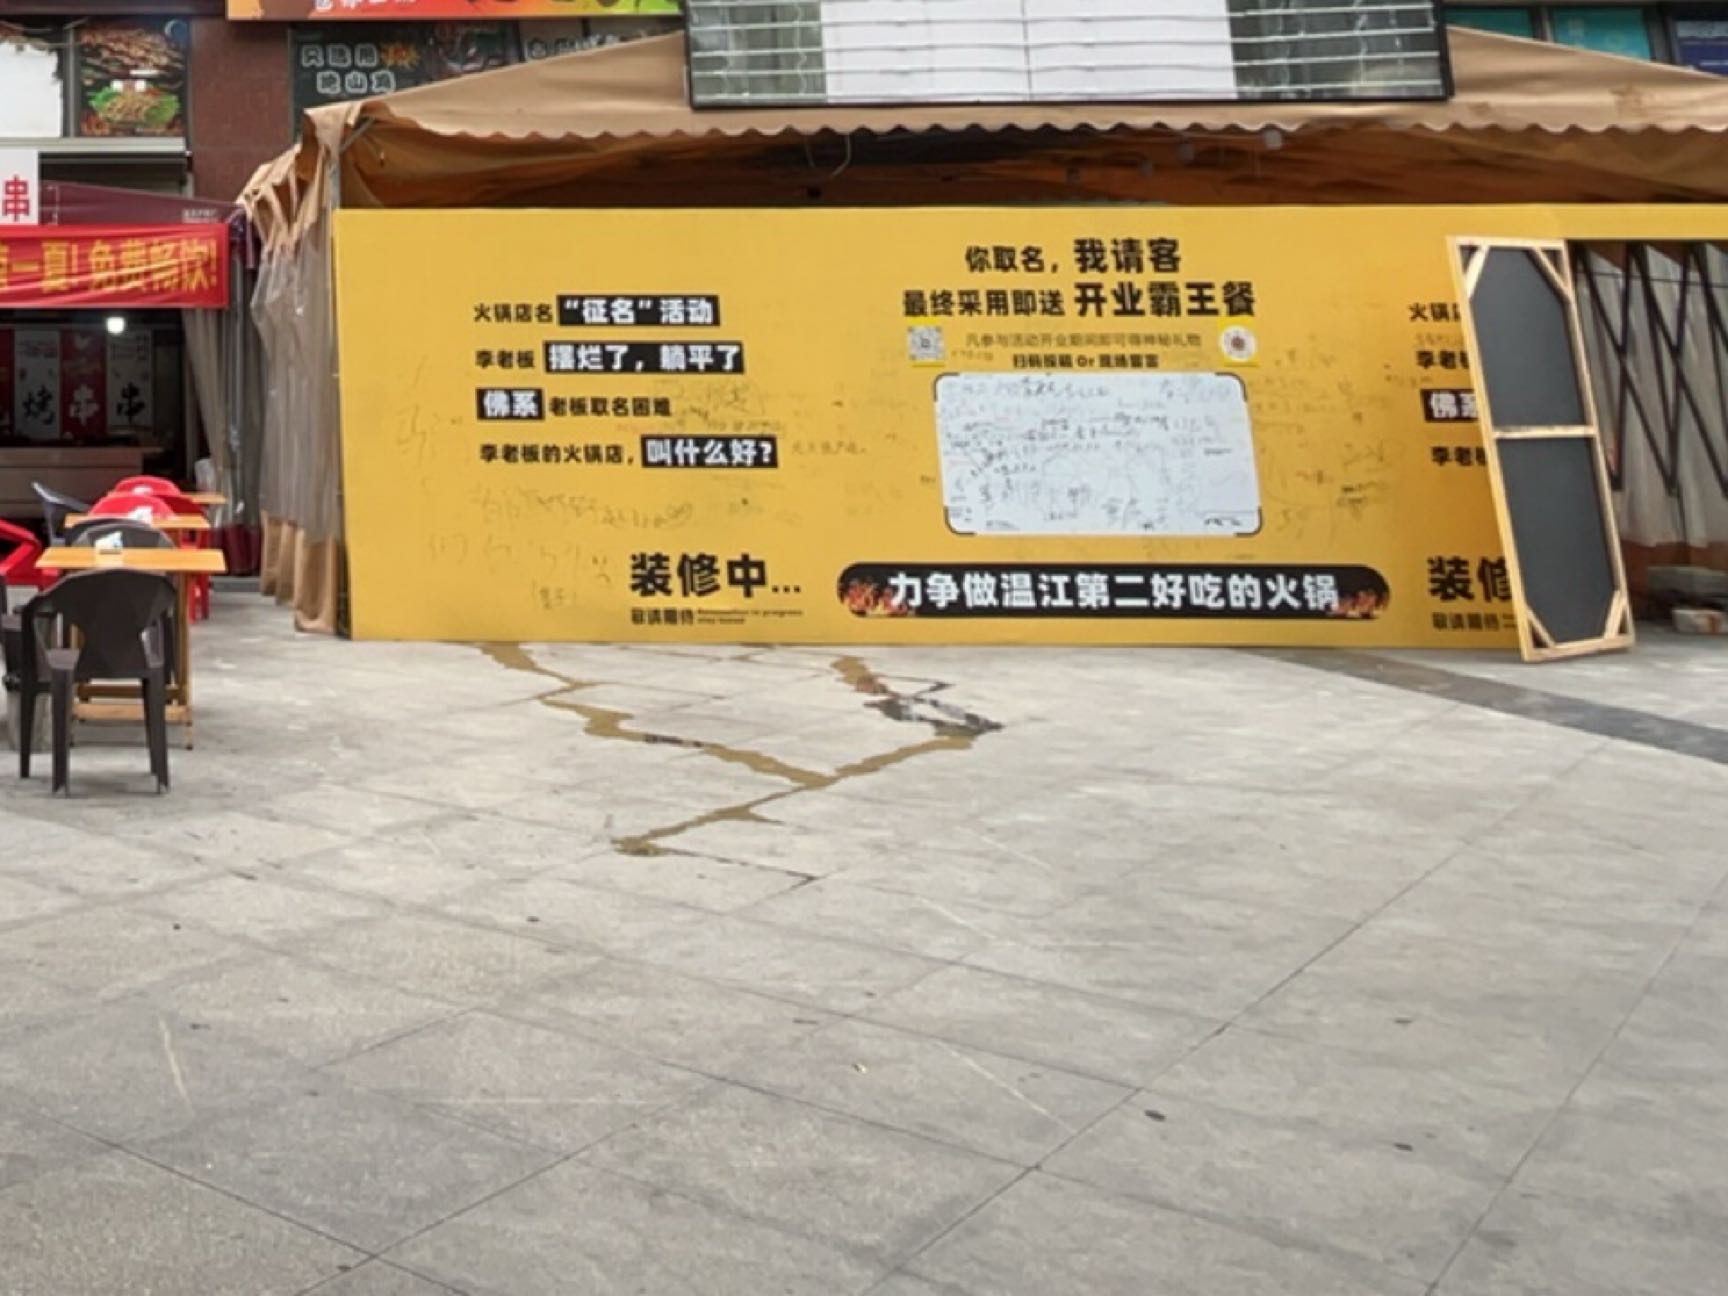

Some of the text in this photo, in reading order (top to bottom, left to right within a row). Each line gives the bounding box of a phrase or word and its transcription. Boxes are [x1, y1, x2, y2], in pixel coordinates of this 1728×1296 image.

[1074, 238, 1182, 274] 我请客
[474, 303, 553, 323] 火锅店名
[903, 282, 1256, 317] 最终采用即送 开业霸王餐
[475, 349, 535, 370] 李老板
[483, 390, 539, 418] 佛系
[550, 397, 671, 418] 老板取名困难
[889, 572, 1340, 611] 力争做温江第二好吃的火锅
